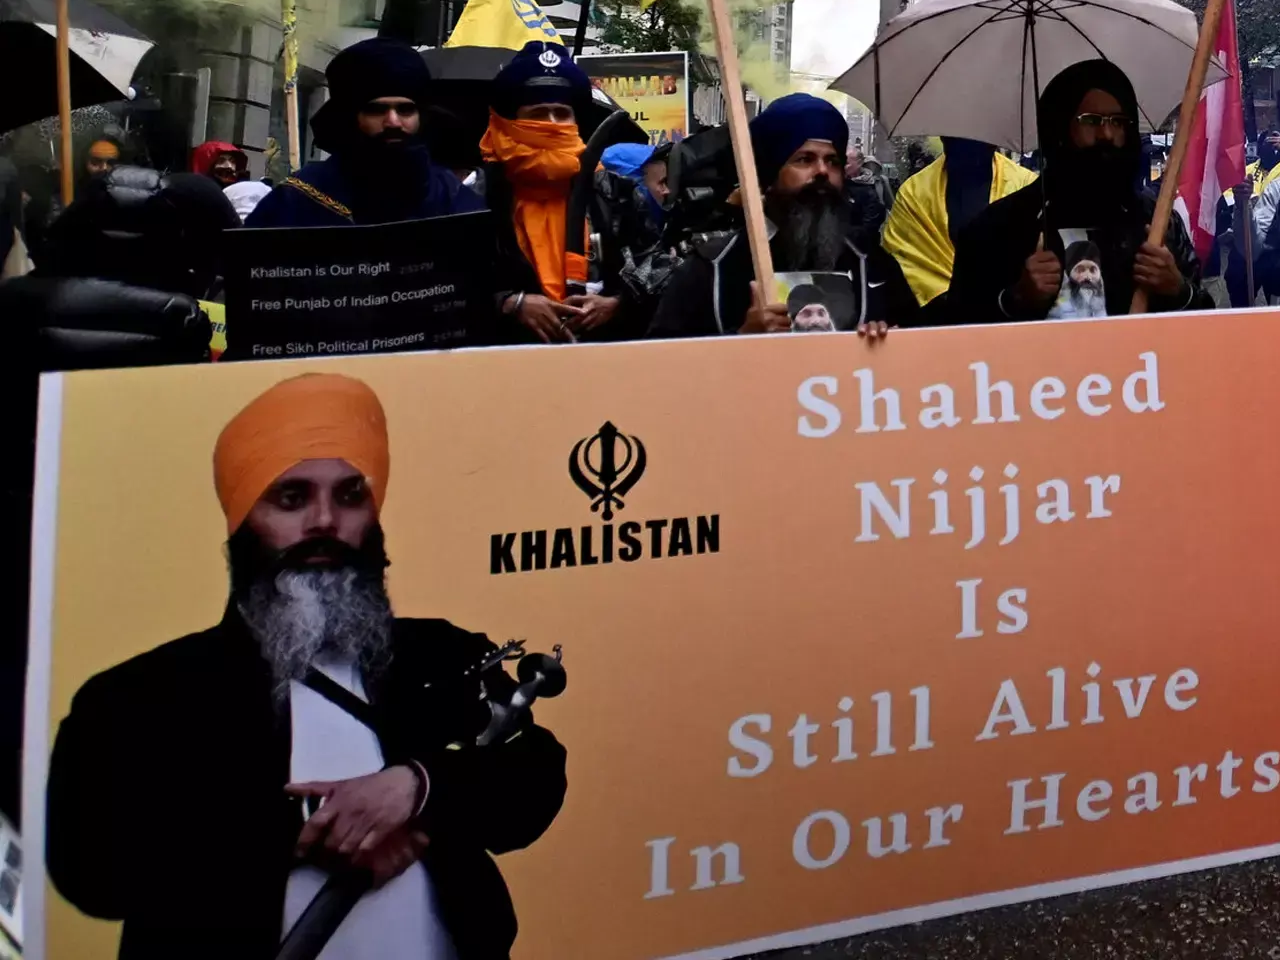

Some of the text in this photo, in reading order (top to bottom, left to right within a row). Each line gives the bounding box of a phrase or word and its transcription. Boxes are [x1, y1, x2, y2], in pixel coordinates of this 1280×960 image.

[250, 267, 312, 279] Khalistan
[315, 265, 327, 277] is
[329, 264, 354, 276] Our
[358, 262, 391, 277] Right
[251, 283, 455, 312] Free Punjab of Indian Occupation
[252, 343, 282, 356] Free
[285, 341, 315, 355] Sikh
[318, 339, 369, 354] Political
[372, 331, 426, 349] Prisoners
[797, 352, 1166, 437] Shaheed
[854, 462, 1121, 549] Nijjar
[490, 514, 720, 575] KHALISTAN
[955, 578, 1029, 639] Is
[727, 661, 1200, 778] Still Alive
[643, 836, 745, 898] In
[791, 804, 964, 869] Our
